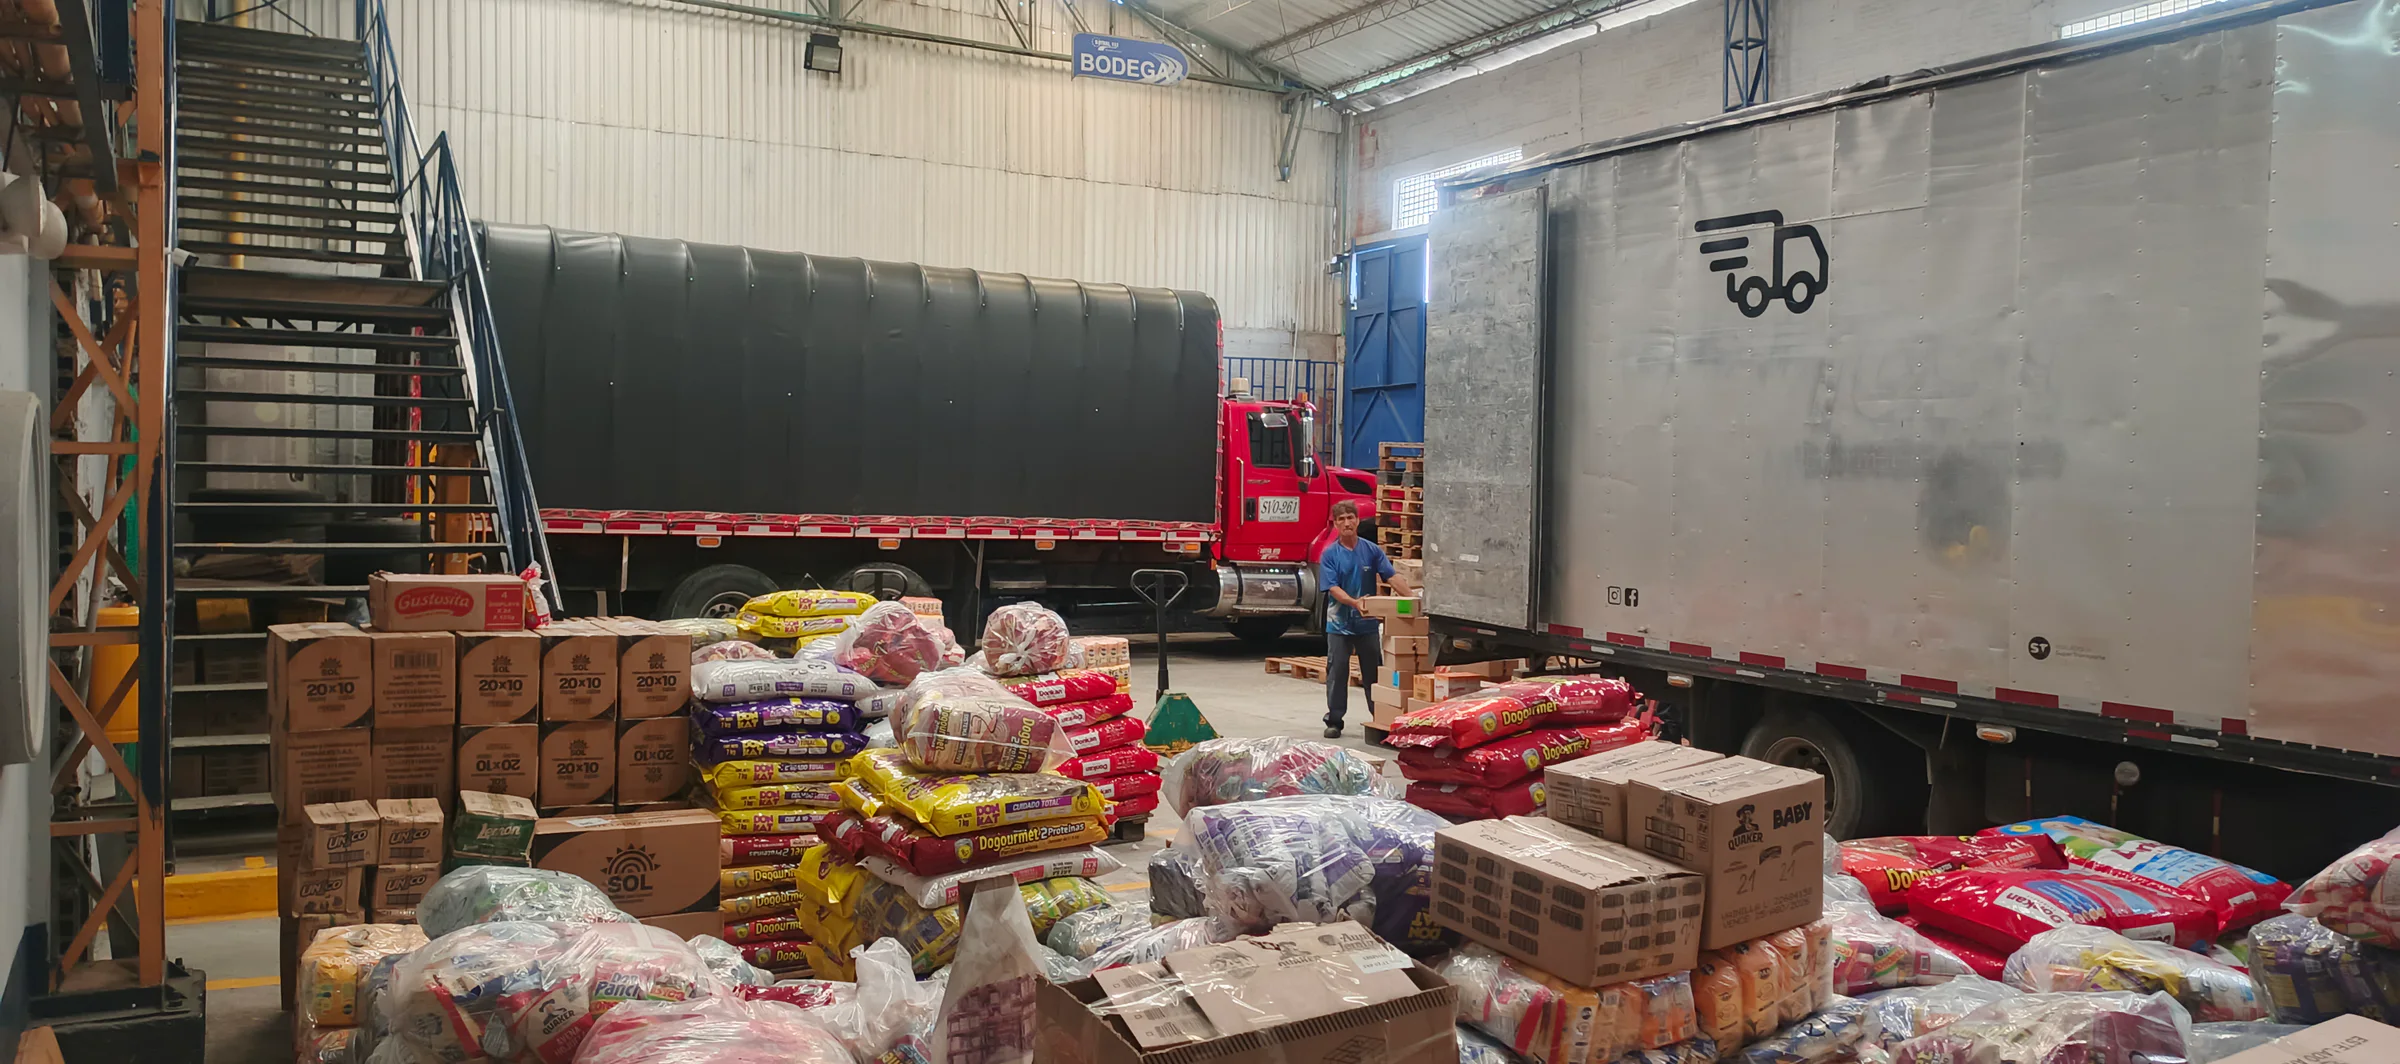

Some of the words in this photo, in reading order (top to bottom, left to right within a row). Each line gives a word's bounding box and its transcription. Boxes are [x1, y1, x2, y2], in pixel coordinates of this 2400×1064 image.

[1080, 52, 1170, 80] BODEGA
[1261, 500, 1298, 514] SVO-261
[398, 592, 470, 610] Gustosita
[2030, 643, 2048, 654] ST
[976, 804, 999, 815] DON
[1012, 801, 1040, 812] CUIDADO
[1041, 798, 1060, 807] TOTAL
[976, 814, 1000, 827] KAT
[1773, 801, 1812, 829] BABY
[327, 830, 368, 850] UNCO
[979, 828, 1040, 852] Dogourmet
[1728, 832, 1764, 851] QUAKER
[607, 874, 653, 893] SOL
[756, 921, 803, 936] Dogourme
[595, 981, 640, 997] Panch
[543, 1010, 575, 1035] QUAKER
